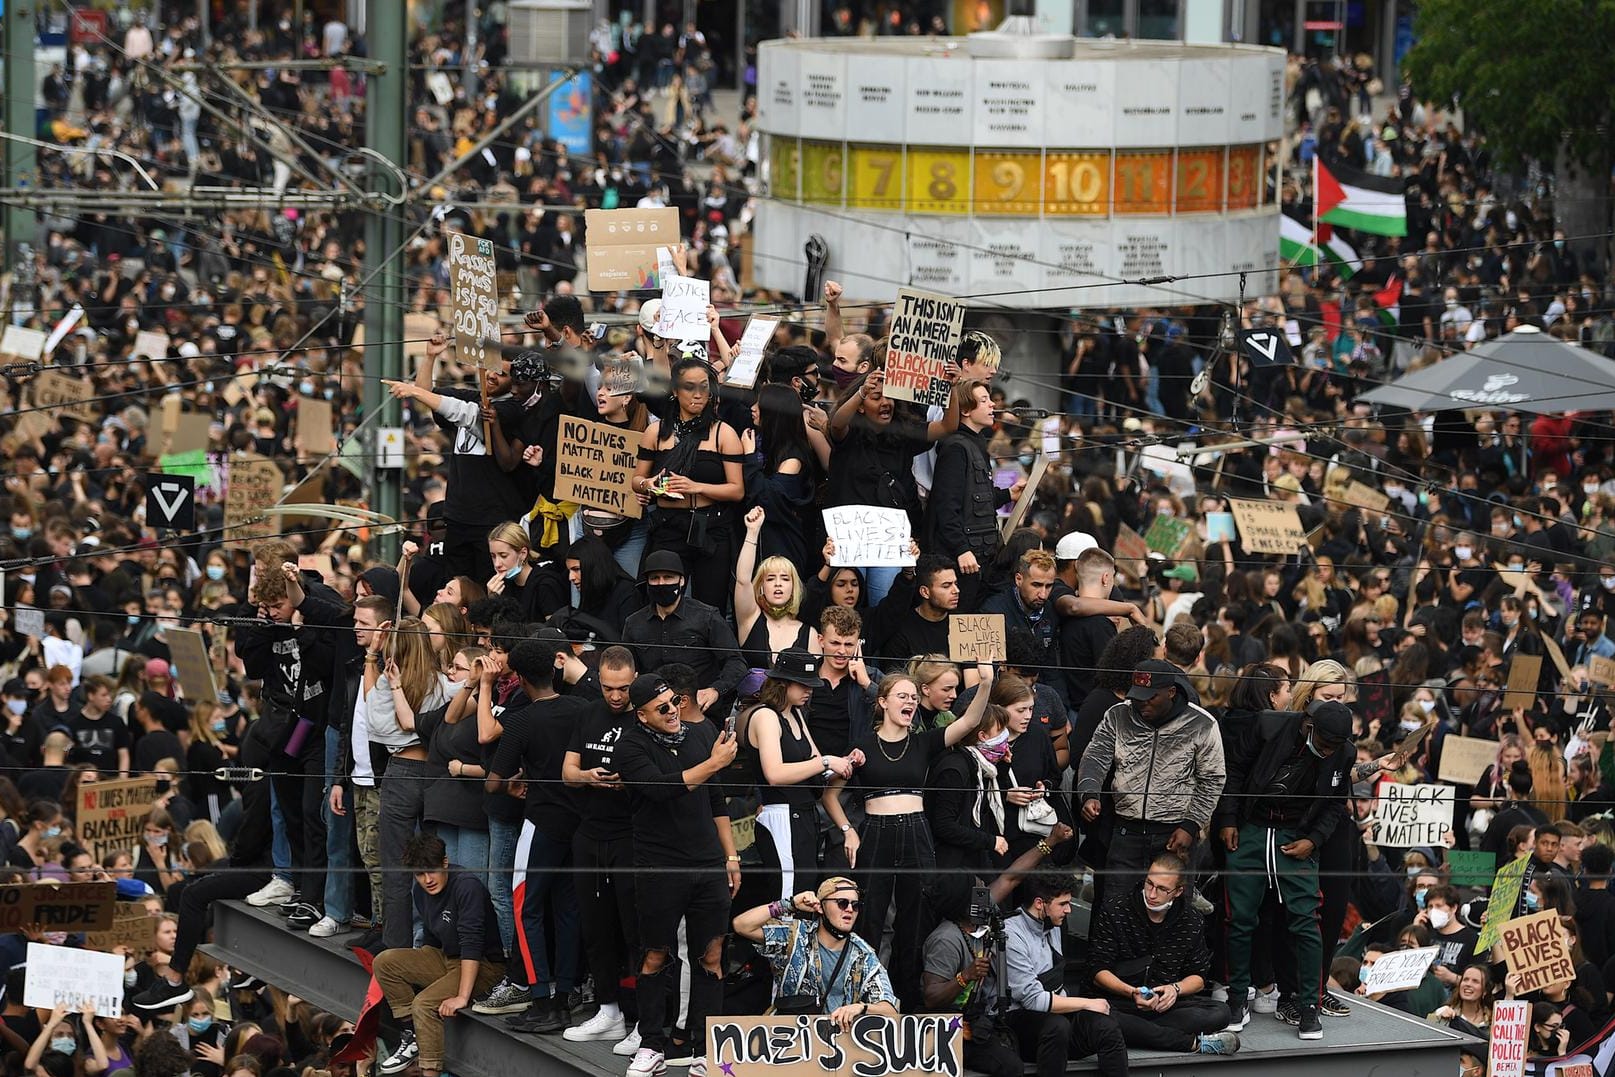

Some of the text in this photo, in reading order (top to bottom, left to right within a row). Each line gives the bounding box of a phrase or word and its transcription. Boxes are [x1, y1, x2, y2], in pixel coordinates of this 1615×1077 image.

[868, 158, 894, 197] 7
[928, 161, 957, 201] 8
[993, 161, 1025, 202] 9
[1049, 161, 1101, 204] 10
[1119, 162, 1154, 204] 11
[1178, 161, 1209, 198] 12
[459, 268, 492, 293] mus
[457, 281, 477, 310] ist
[901, 295, 968, 324] THIS ISN'T
[892, 315, 912, 335] AN
[890, 335, 961, 362] CAN THING
[887, 350, 928, 375] BLACK
[885, 368, 929, 391] MATTER
[913, 388, 949, 407] WHERE
[564, 422, 626, 450] NO LIVES
[562, 442, 637, 469] MATTER UNTIL
[560, 462, 593, 479] BLACK
[572, 483, 626, 514] MATTER!
[832, 511, 893, 526] BLACK
[835, 526, 897, 542] LIVES
[956, 616, 992, 633] BLACK
[975, 630, 1000, 643] LIVES
[959, 641, 1005, 659] MATTER
[99, 788, 123, 809] LIVES
[126, 785, 157, 806] MATTE
[1388, 786, 1445, 805] BLACK
[82, 818, 122, 841] BLACK
[1386, 822, 1450, 845] MATTER
[34, 903, 100, 924] PRIDE
[1503, 916, 1562, 951] BLACK
[1511, 941, 1563, 971] LIVES
[1495, 1004, 1524, 1021] DON'T
[1493, 1024, 1514, 1040] CALL
[1492, 1043, 1523, 1060] POLICE
